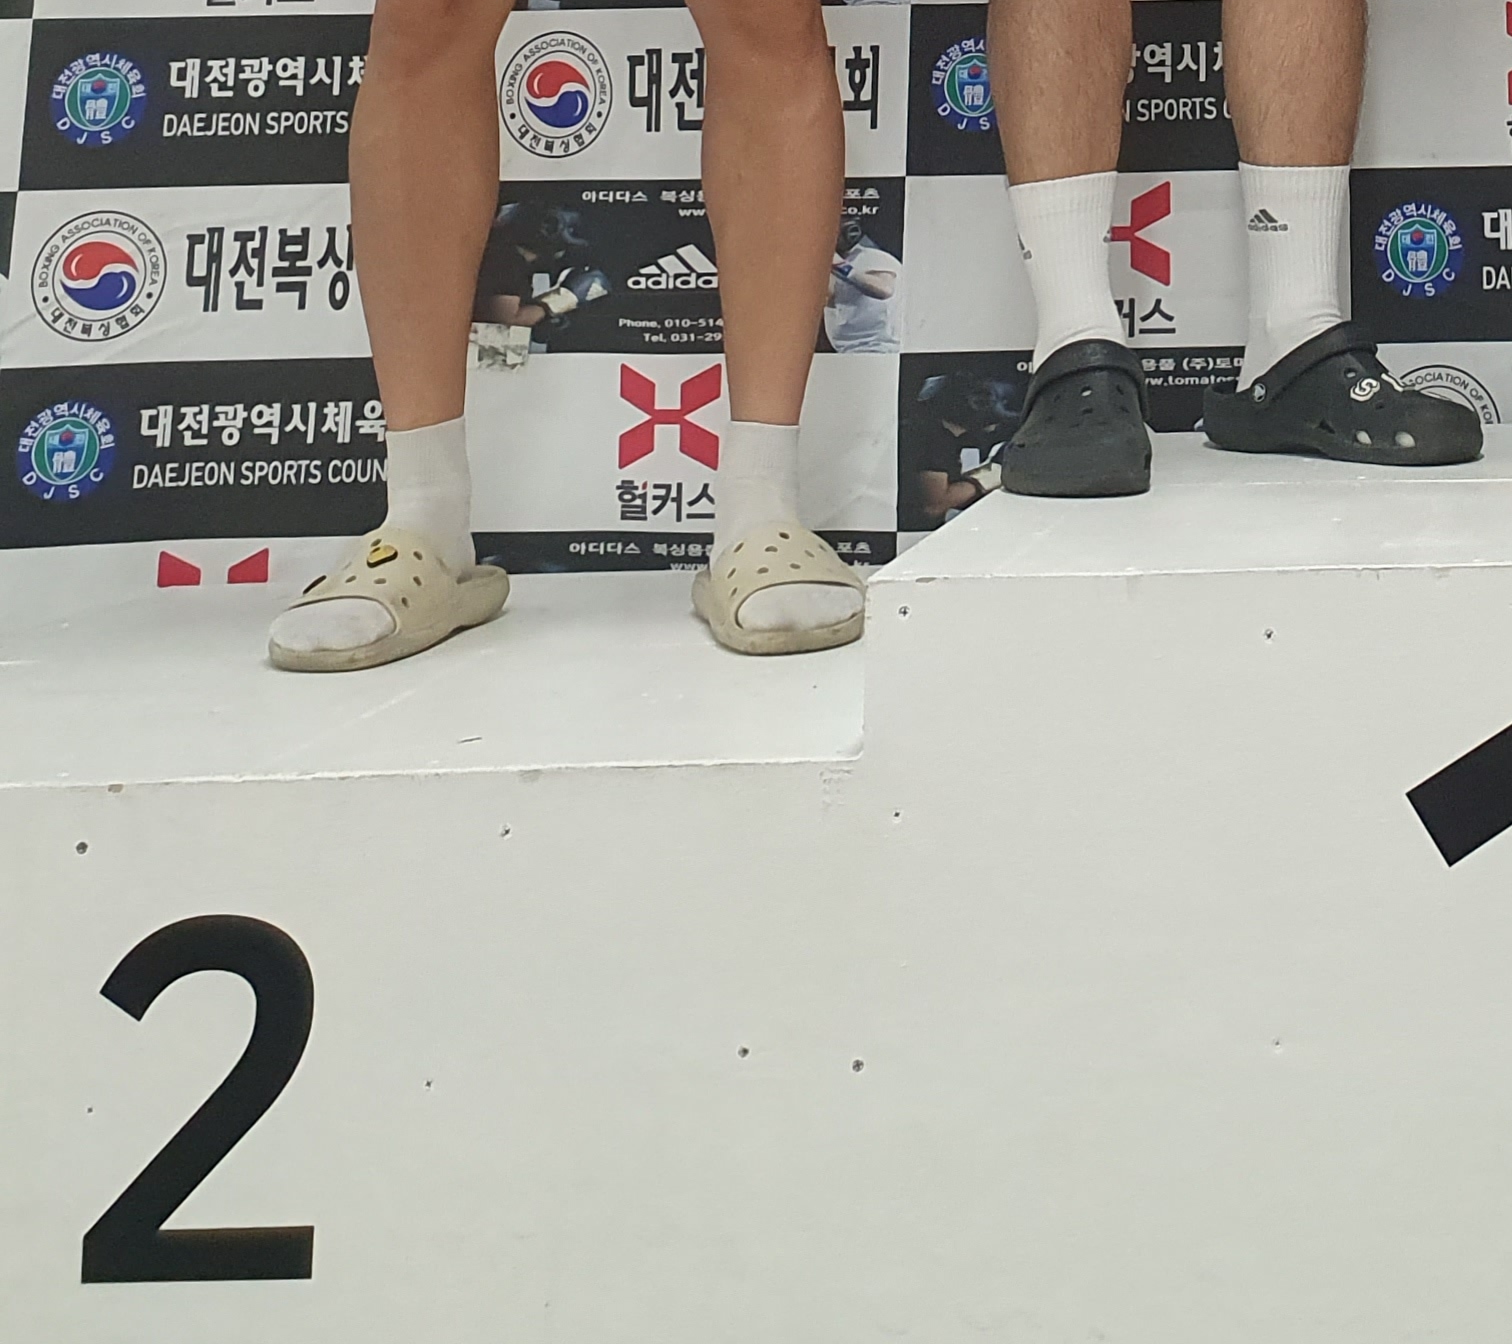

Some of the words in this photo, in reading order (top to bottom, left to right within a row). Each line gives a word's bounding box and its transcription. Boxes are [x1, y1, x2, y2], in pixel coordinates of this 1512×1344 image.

[1136, 98, 1218, 121] SPORTS
[163, 113, 259, 137] DAEJEON
[265, 111, 348, 134] SPORTS
[582, 190, 647, 203] 아디다스
[133, 462, 233, 489] DAEJEON
[240, 461, 323, 484] SPORTS
[569, 541, 641, 555] 아디다스
[80, 912, 315, 1284] 2
